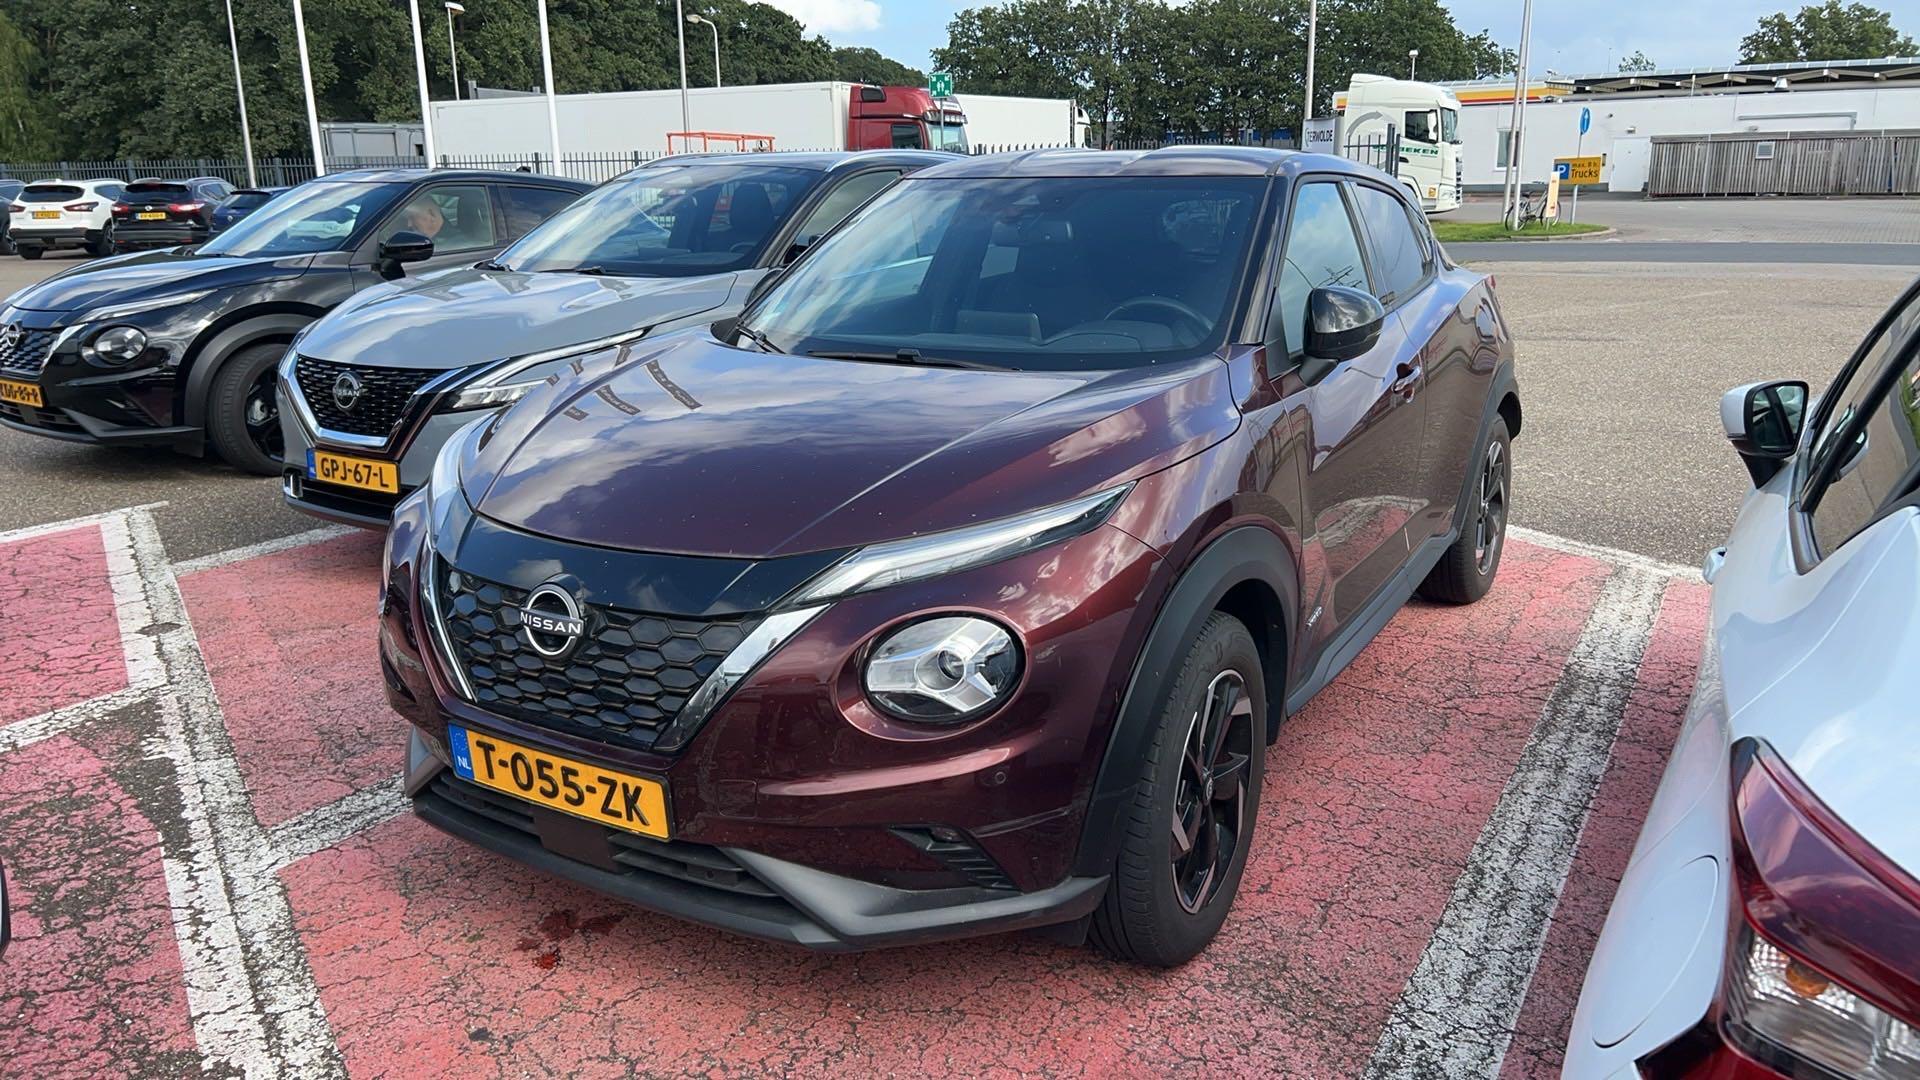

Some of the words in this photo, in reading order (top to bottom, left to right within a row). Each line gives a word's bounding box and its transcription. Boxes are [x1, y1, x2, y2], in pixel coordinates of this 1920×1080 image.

[1307, 129, 1333, 143] TERWOLDE
[1571, 168, 1599, 178] Trucks
[321, 457, 389, 488] GPJ-67-L
[520, 611, 581, 634] NISSAN
[457, 755, 471, 770] NL
[476, 739, 649, 826] T-055-ZK
